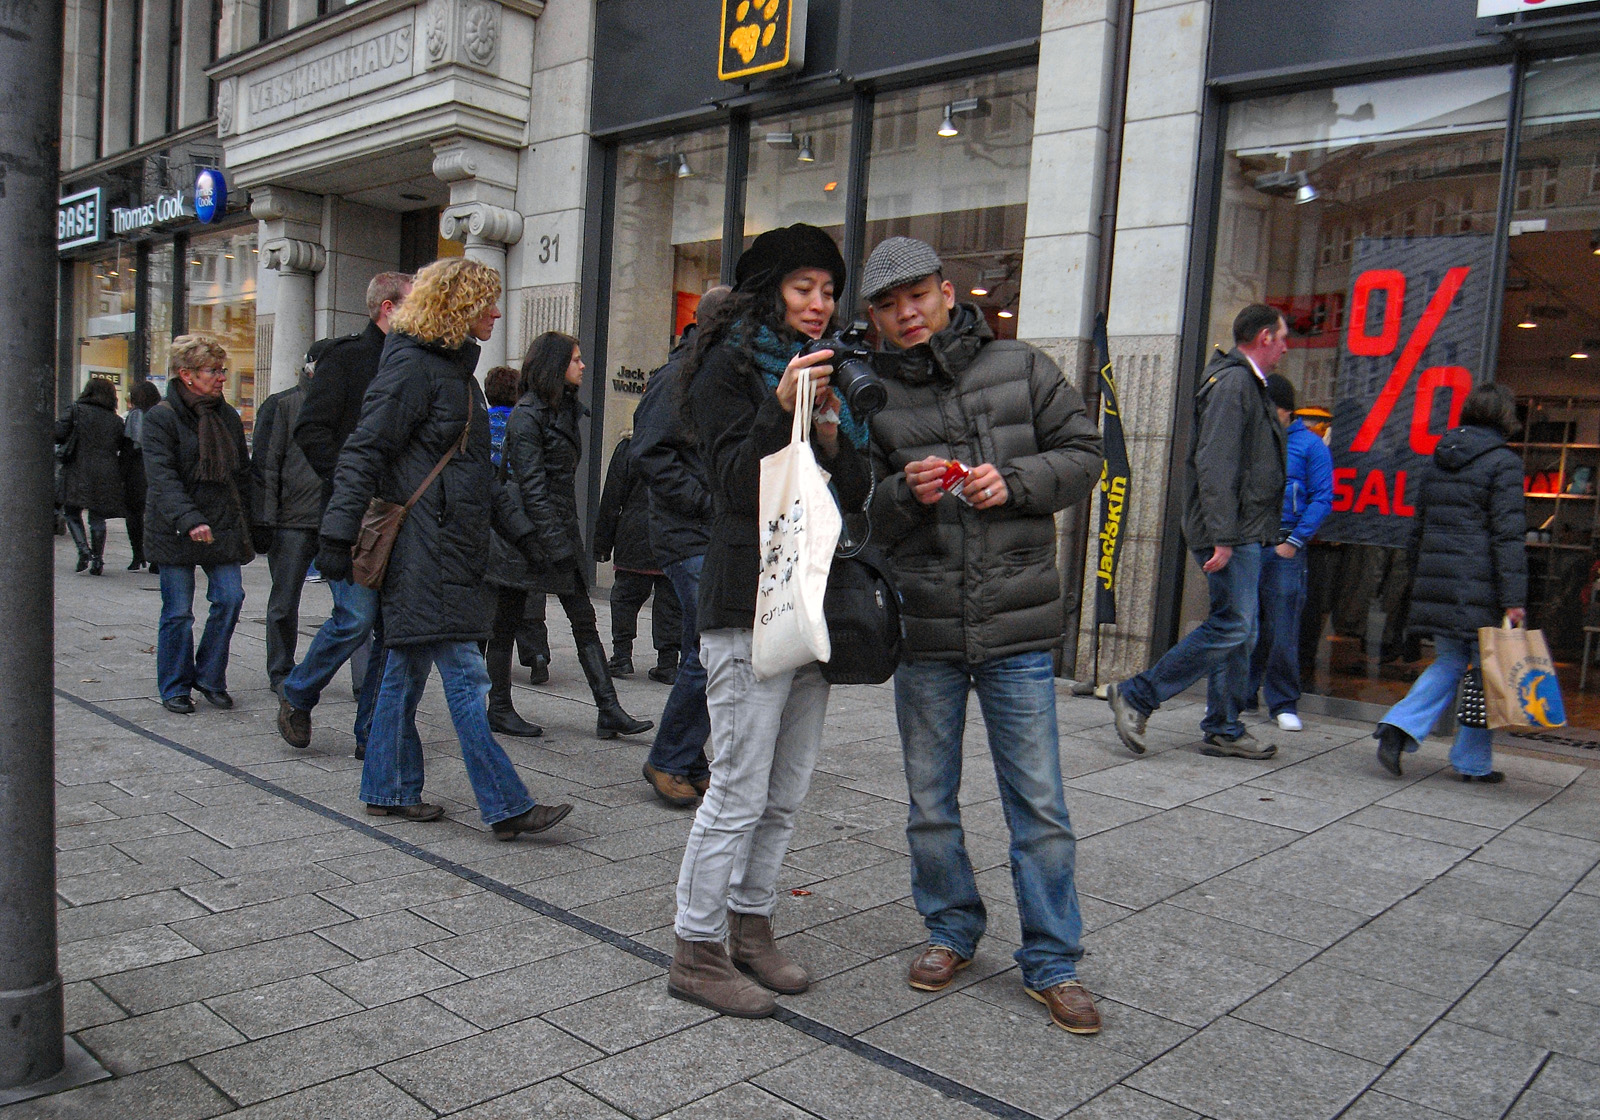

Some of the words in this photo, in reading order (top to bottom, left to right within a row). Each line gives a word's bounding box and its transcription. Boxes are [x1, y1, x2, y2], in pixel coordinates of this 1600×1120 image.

[112, 204, 154, 234] Thomas
[156, 190, 185, 222] Cook
[198, 196, 214, 207] Cook
[58, 201, 95, 240] BASE
[539, 234, 560, 264] 31
[617, 366, 645, 380] Jack
[1331, 468, 1416, 517] SAL
